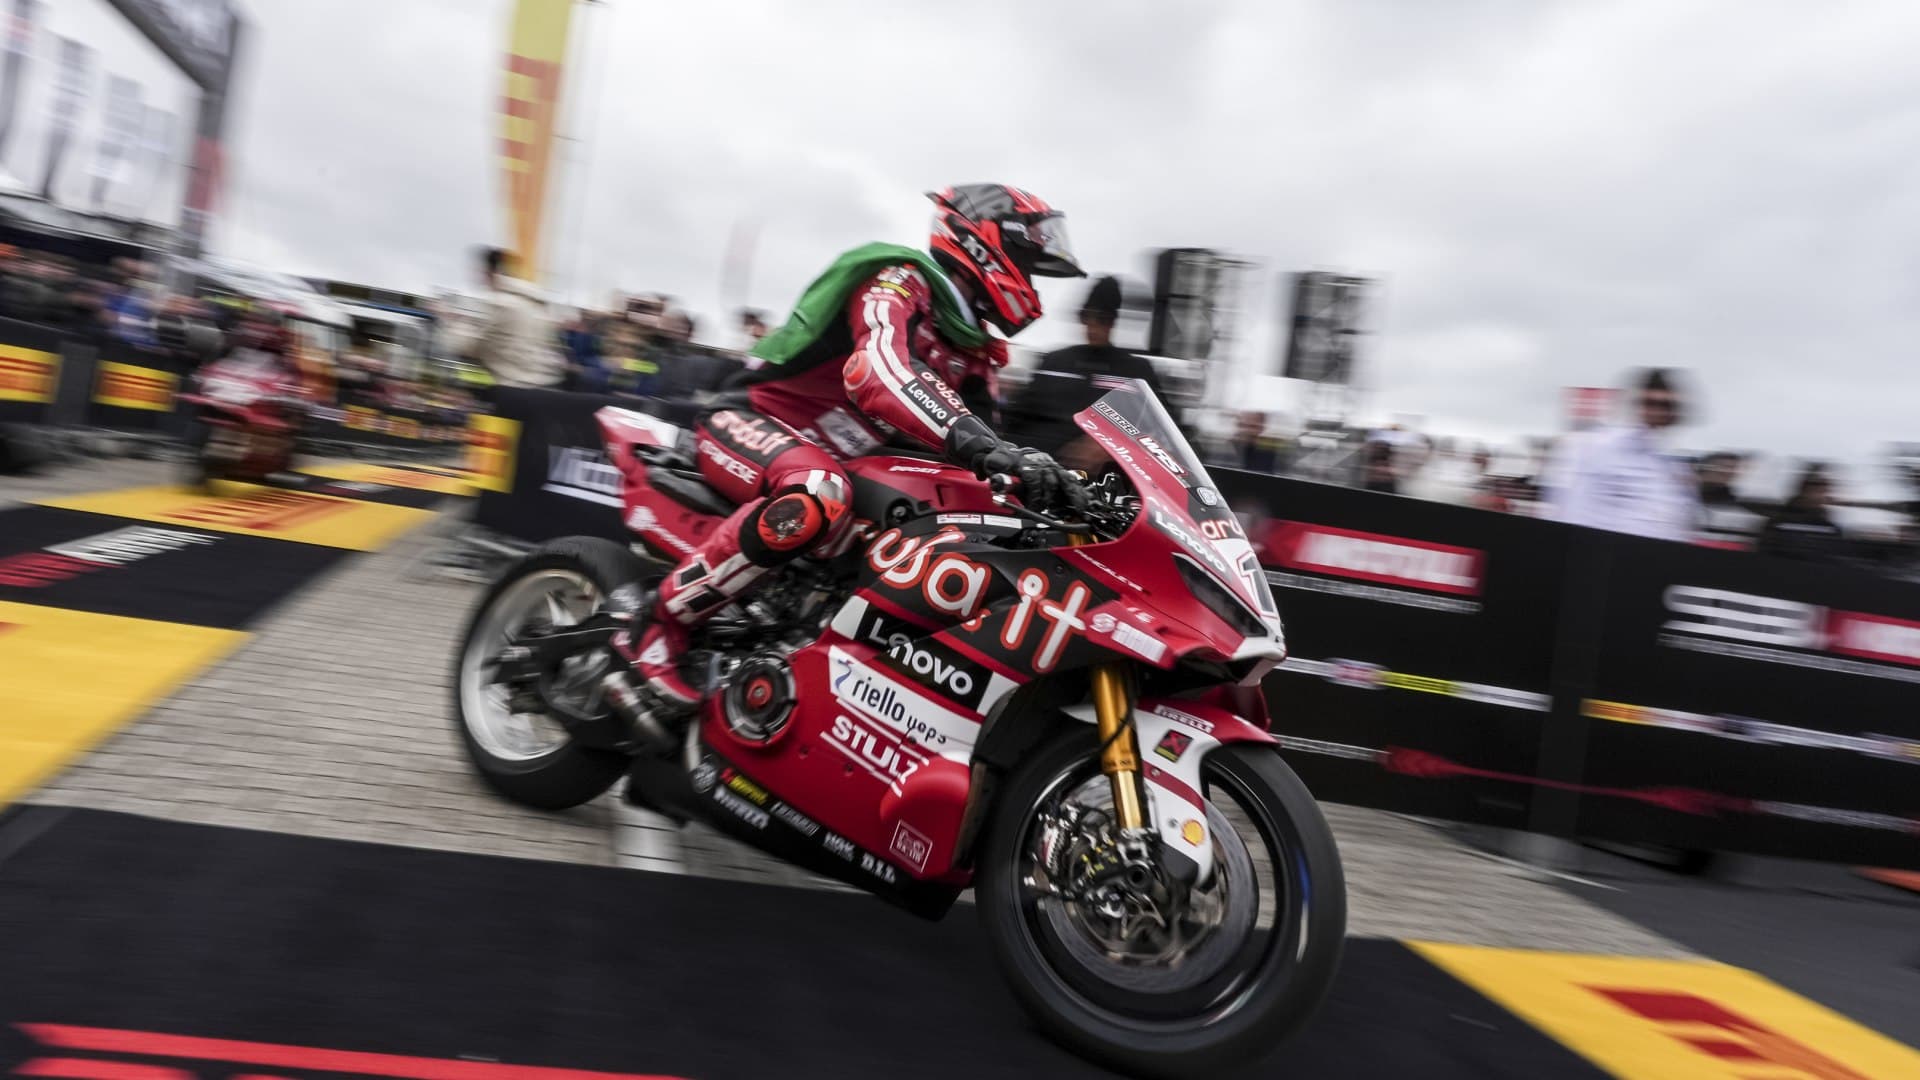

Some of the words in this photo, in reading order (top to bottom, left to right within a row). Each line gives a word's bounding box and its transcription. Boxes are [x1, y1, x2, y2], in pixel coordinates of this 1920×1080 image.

[907, 383, 947, 421] Lenovo
[1155, 511, 1226, 572] Lenovo
[868, 617, 974, 695] Lenovo
[851, 677, 906, 722] riello
